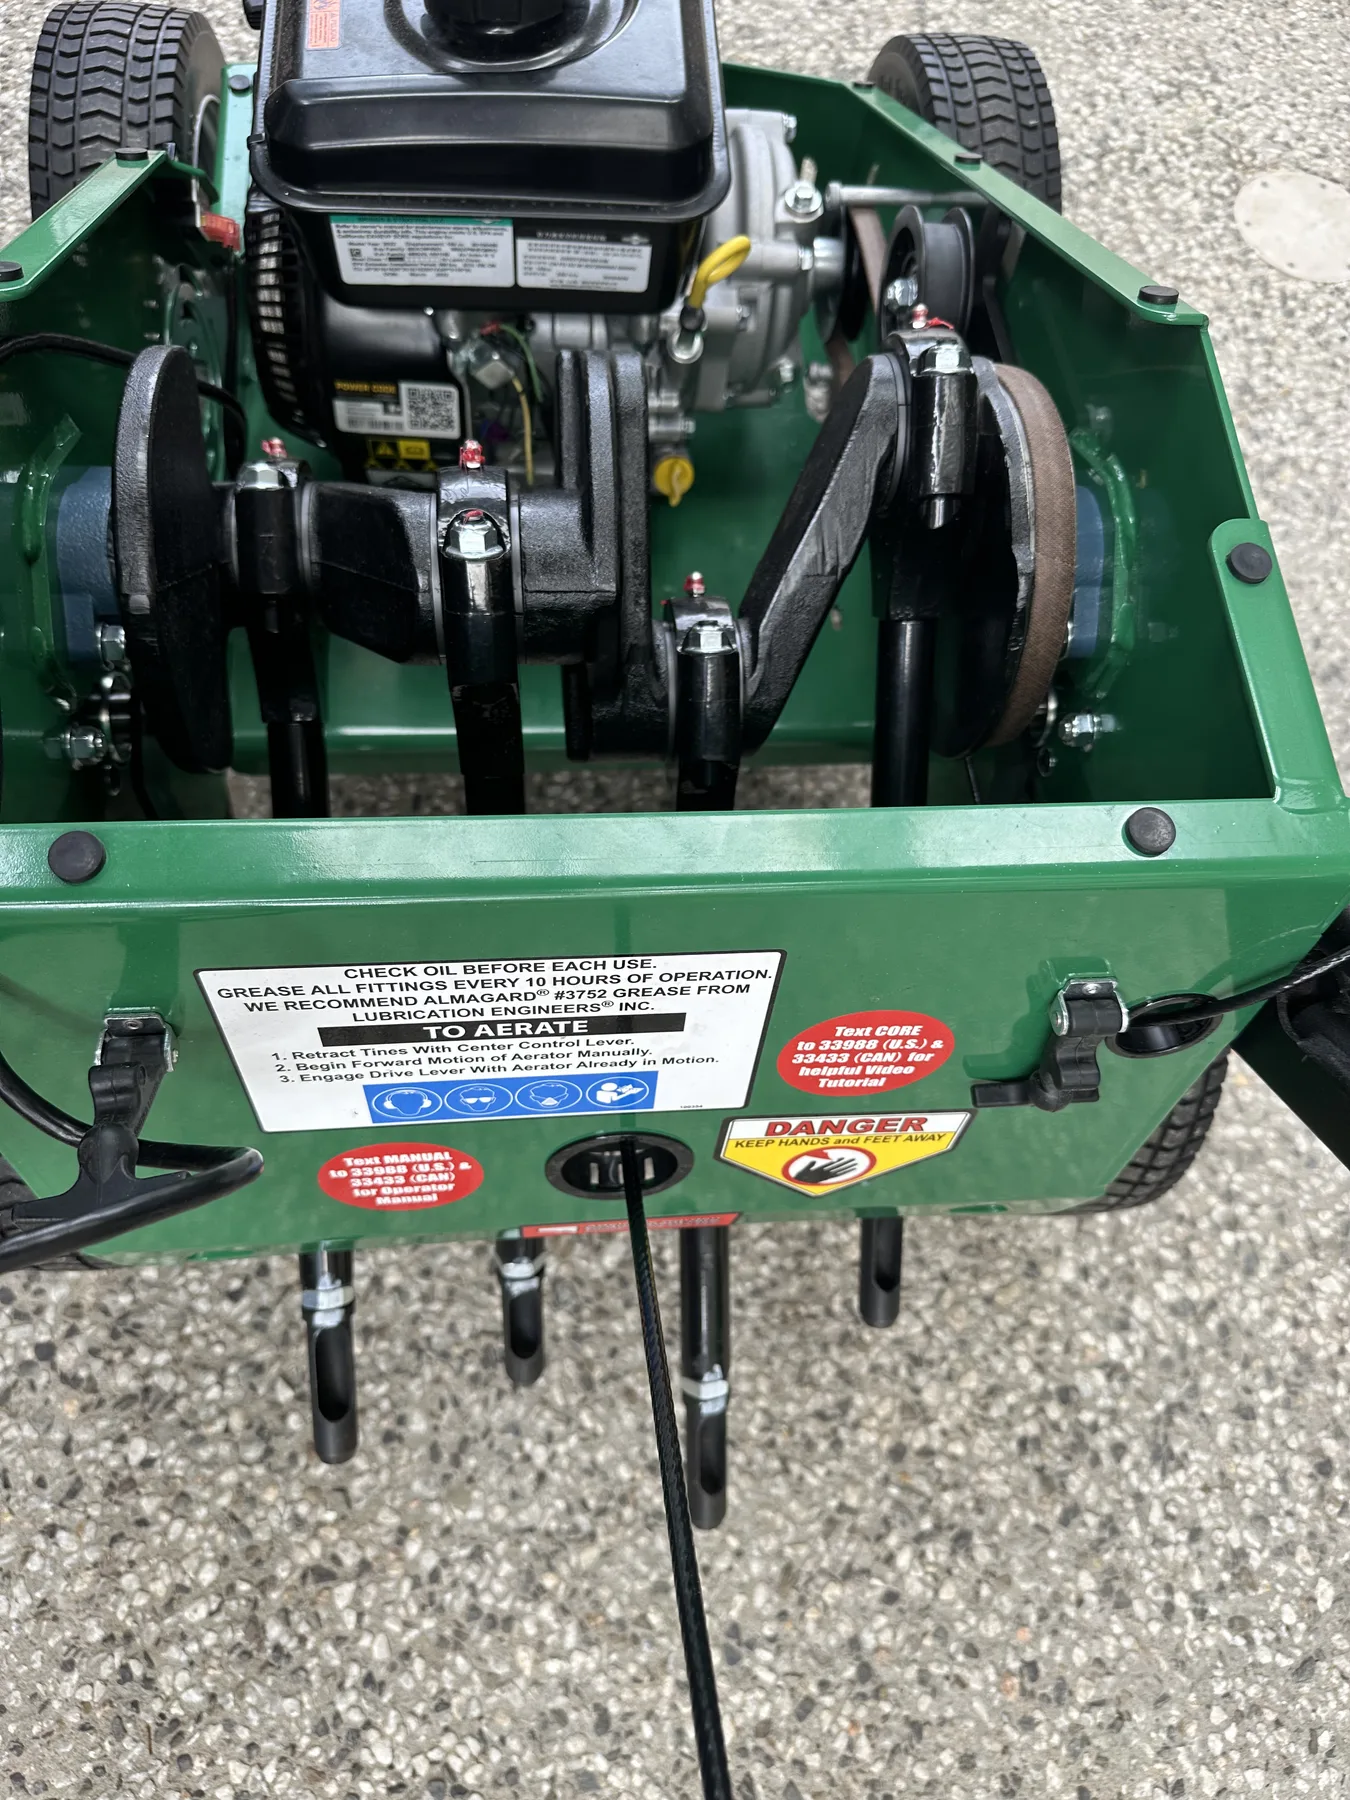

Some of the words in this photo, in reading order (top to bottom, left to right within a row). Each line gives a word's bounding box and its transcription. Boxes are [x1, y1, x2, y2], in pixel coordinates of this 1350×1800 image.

[344, 967, 417, 979] CHECK
[423, 965, 457, 976] OIL
[463, 962, 546, 975] BEFORE
[552, 960, 606, 972] EACH
[613, 959, 657, 970] USE.
[217, 985, 305, 999] GREASE
[311, 984, 350, 995] ALL
[356, 980, 447, 993] FITTINGS
[454, 977, 522, 990] EVERY
[525, 977, 546, 988] 10
[552, 975, 621, 987] HOURS
[627, 974, 653, 984] OF
[659, 969, 772, 982] OPERATION.
[244, 1002, 278, 1012] WE
[284, 996, 418, 1012] RECOMMEND
[554, 989, 607, 1001] #3752
[613, 986, 691, 998] GREASE
[697, 984, 751, 995] FROM
[352, 1007, 485, 1022] LUBRICATION
[619, 1001, 655, 1012] INC.
[423, 1025, 466, 1039] TO
[474, 1020, 589, 1037] AERATE
[835, 1026, 872, 1037] Text
[875, 1025, 923, 1036] CORE
[271, 1052, 287, 1061] 1.
[292, 1049, 355, 1060] Retract
[360, 1047, 408, 1057] Tines
[412, 1045, 453, 1054] With
[457, 1041, 514, 1053] Center
[519, 1039, 580, 1050] Control
[580, 1037, 634, 1048] Lever.
[797, 1041, 815, 1051] to
[819, 1039, 878, 1050] 33988
[882, 1039, 927, 1050] (U.S.)
[931, 1040, 944, 1048] &
[275, 1063, 291, 1072] 2.
[296, 1061, 347, 1073] Begin
[352, 1057, 421, 1069] Forward
[428, 1055, 485, 1065] Motion
[491, 1052, 508, 1062] of
[512, 1051, 572, 1061] Aerator
[578, 1048, 652, 1060] Manually.
[792, 1053, 850, 1064] 33433
[854, 1052, 902, 1063] (CAN)
[907, 1052, 935, 1062] for
[280, 1075, 295, 1084] 3.
[300, 1072, 364, 1085] Engage
[369, 1068, 413, 1079] Drive
[419, 1066, 465, 1077] Lever
[470, 1064, 508, 1074] With
[512, 1062, 572, 1072] Aerator
[577, 1058, 636, 1071] Already
[643, 1058, 656, 1066] in
[662, 1056, 719, 1065] Motion.
[799, 1065, 862, 1077] helpful
[865, 1065, 915, 1074] Video
[818, 1077, 887, 1088] Tutorial
[765, 1117, 928, 1136] DANGER
[735, 1139, 775, 1148] KEEP
[778, 1138, 830, 1146] HANDS
[834, 1136, 860, 1145] and
[864, 1135, 901, 1144] FEET
[905, 1133, 946, 1143] AWAY
[343, 1156, 381, 1167] Text
[383, 1152, 453, 1165] MANUAL
[329, 1170, 348, 1179] to
[412, 1162, 455, 1173] (U.S.)
[459, 1162, 472, 1170] &
[351, 1176, 405, 1187] 33433
[410, 1172, 455, 1183] (CAN)
[353, 1187, 378, 1197] for
[380, 1183, 455, 1196] Operator
[376, 1193, 438, 1206] Manual
